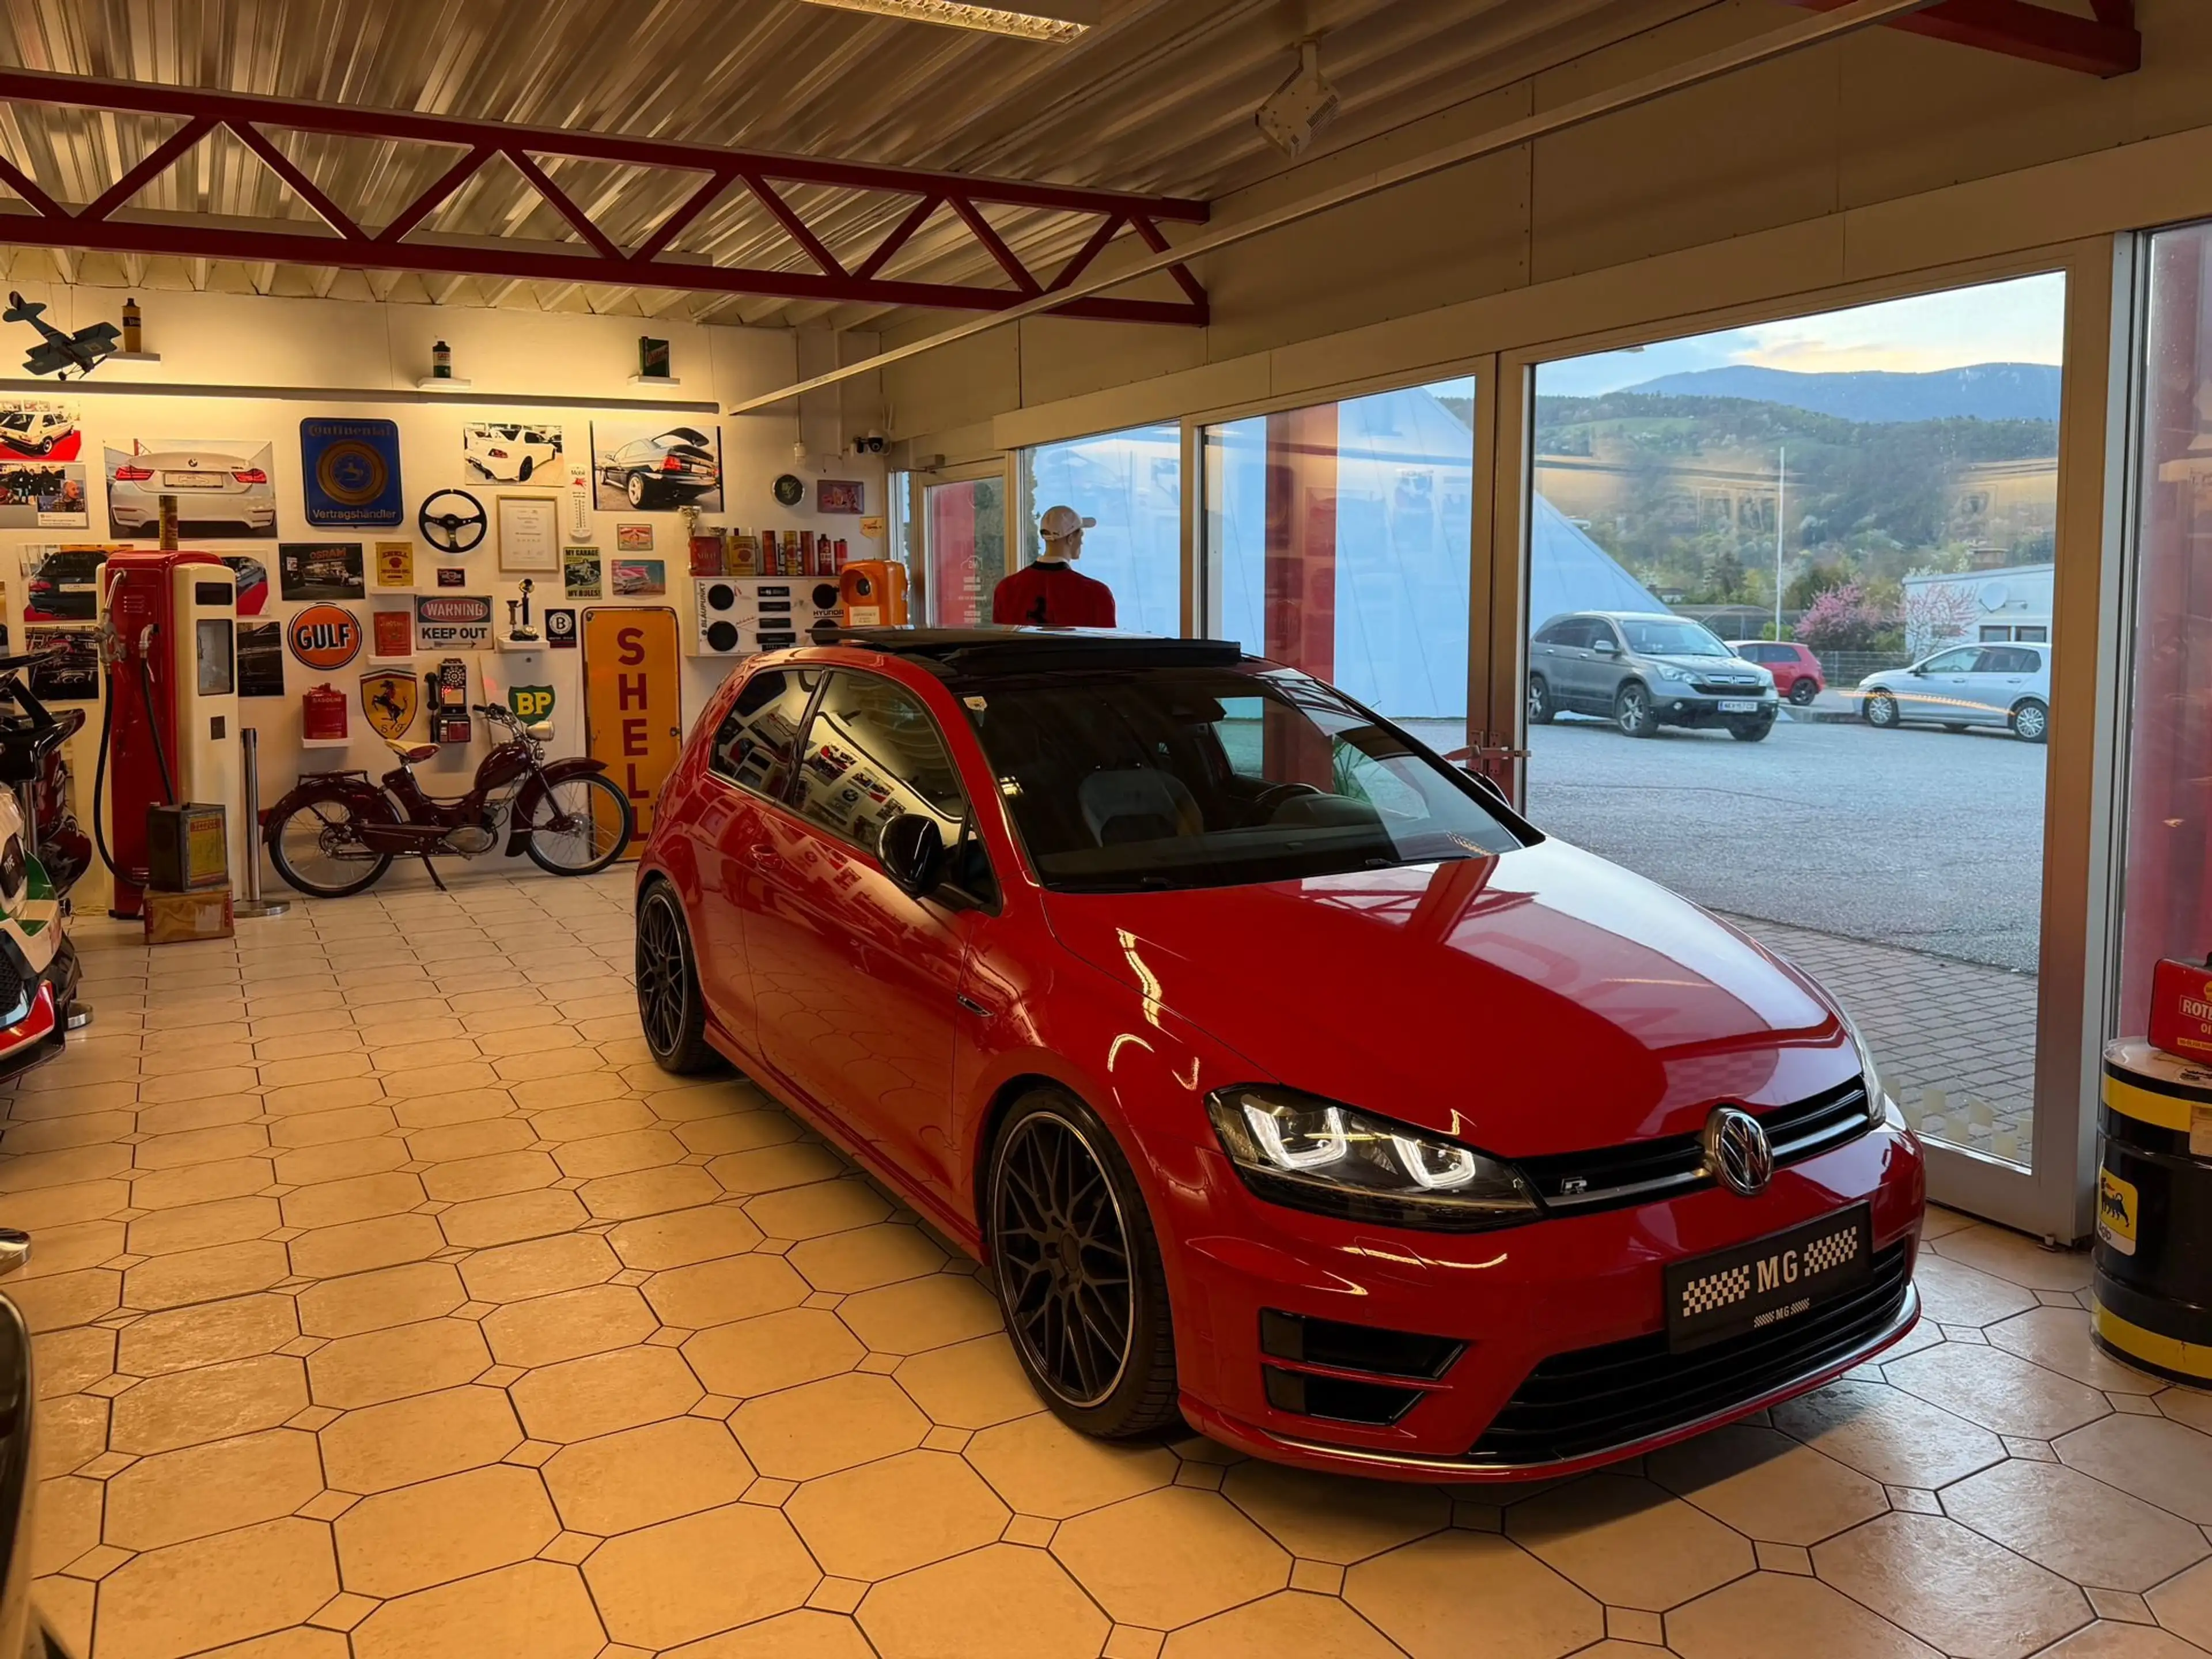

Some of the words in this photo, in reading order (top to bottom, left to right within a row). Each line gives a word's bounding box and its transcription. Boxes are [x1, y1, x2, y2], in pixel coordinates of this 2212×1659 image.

[309, 547, 347, 560] OSRAM
[427, 603, 483, 616] WARNING
[699, 582, 707, 628] BLAUPUNKT
[556, 617, 566, 629] B
[296, 624, 350, 650] GULF
[422, 628, 456, 639] KEEP
[460, 628, 488, 639] OUT
[516, 692, 551, 715] BP
[617, 627, 650, 842] SHELL
[1756, 1250, 1798, 1293] MG
[1775, 1306, 1790, 1320] MG
